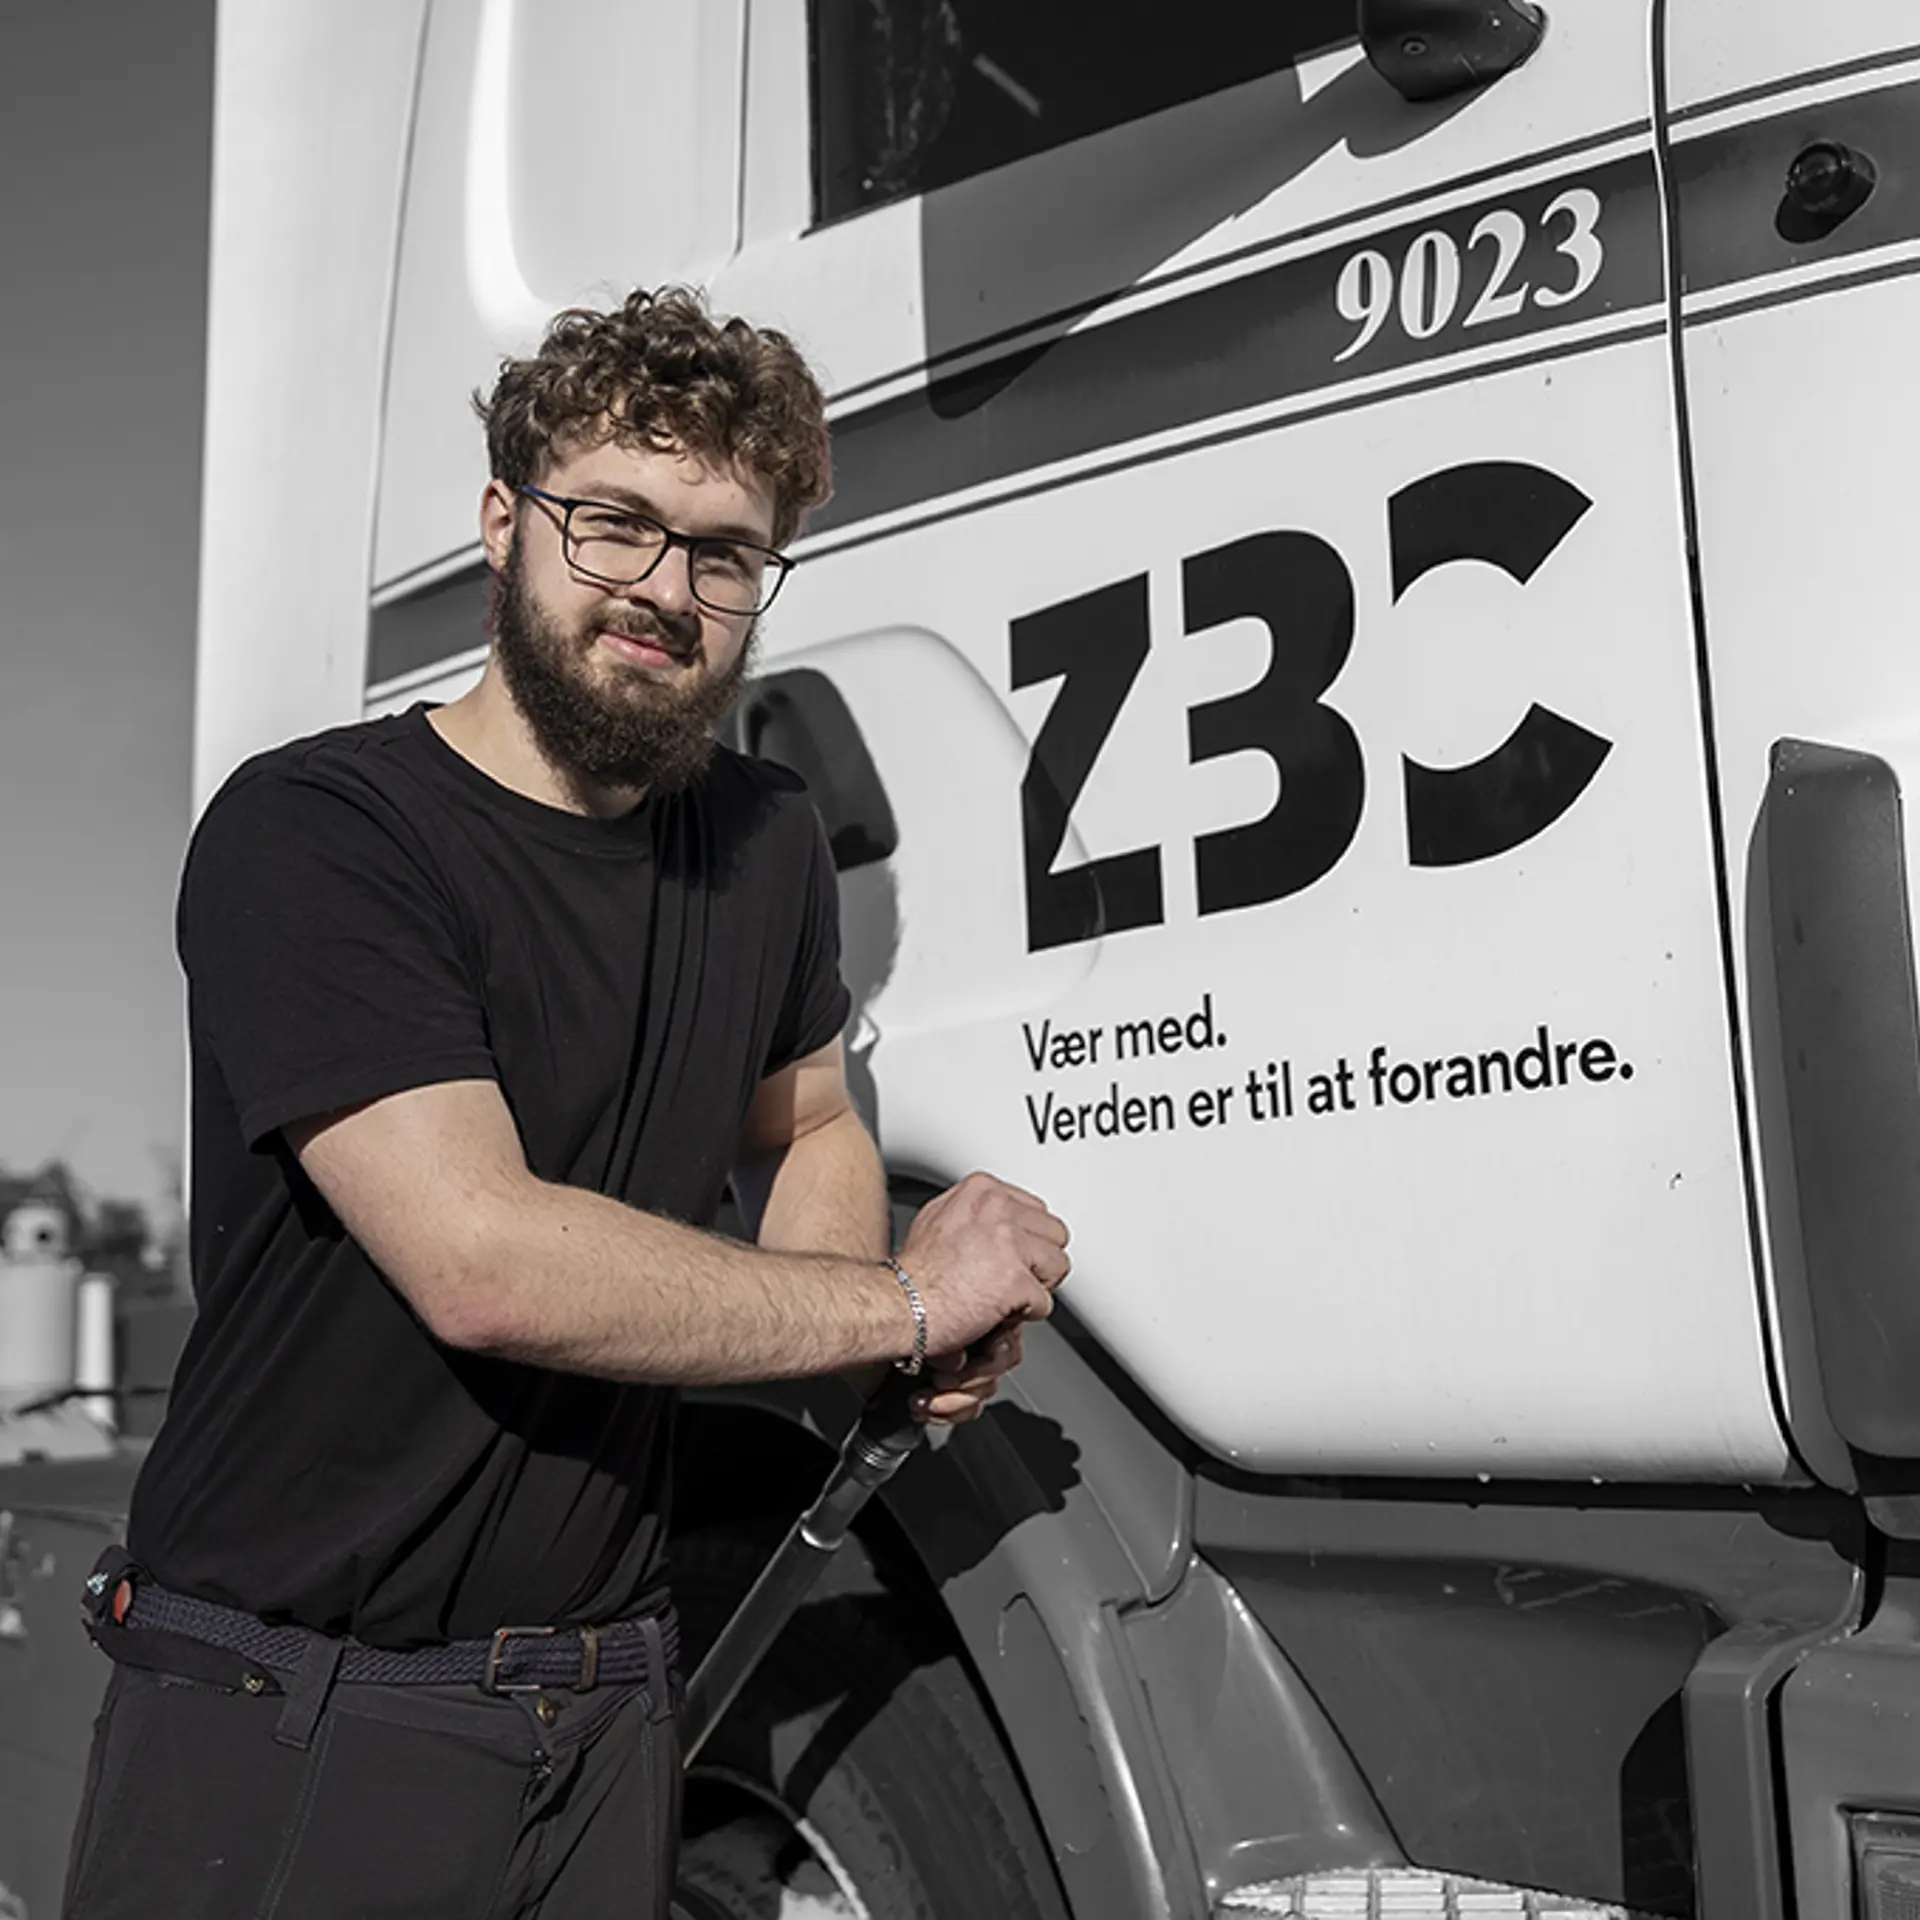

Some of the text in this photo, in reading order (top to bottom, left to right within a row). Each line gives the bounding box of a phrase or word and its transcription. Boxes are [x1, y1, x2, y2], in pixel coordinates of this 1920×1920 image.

[1333, 189, 1603, 363] 9023
[1008, 460, 1615, 954] ZBC
[1022, 993, 1228, 1072] Vær med.
[1025, 1025, 1635, 1146] Verden er til at forandre.
